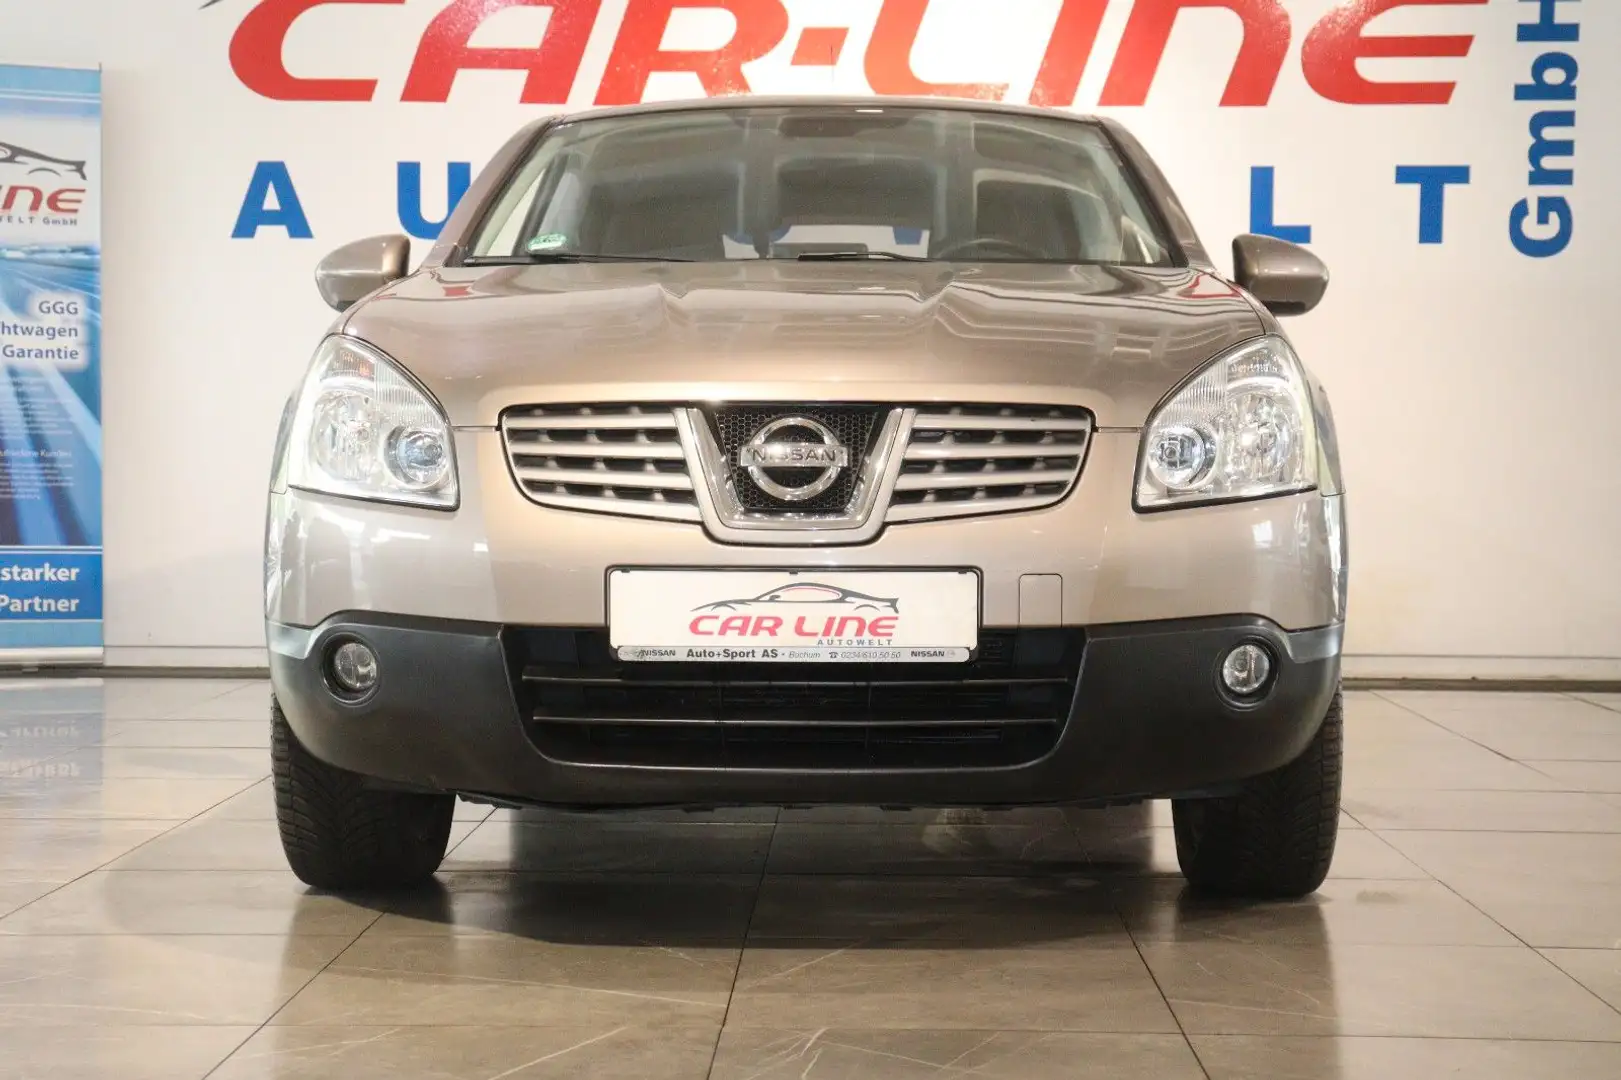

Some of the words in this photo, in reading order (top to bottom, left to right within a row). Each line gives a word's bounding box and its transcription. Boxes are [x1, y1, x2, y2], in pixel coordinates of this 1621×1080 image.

[1508, 0, 1580, 258] GmbH
[0, 185, 86, 213] NE
[0, 215, 34, 224] ELT
[42, 216, 77, 226] GmbH
[38, 300, 79, 315] GGG
[0, 320, 78, 340] htwagen
[2, 344, 79, 360] Garantie
[752, 448, 837, 462] NSAN
[0, 562, 79, 581] starker
[689, 615, 783, 637] CAR
[794, 615, 899, 637] LINE
[686, 648, 756, 659] Auto+Sport
[761, 649, 779, 658] AS
[910, 650, 945, 658] NISSAN
